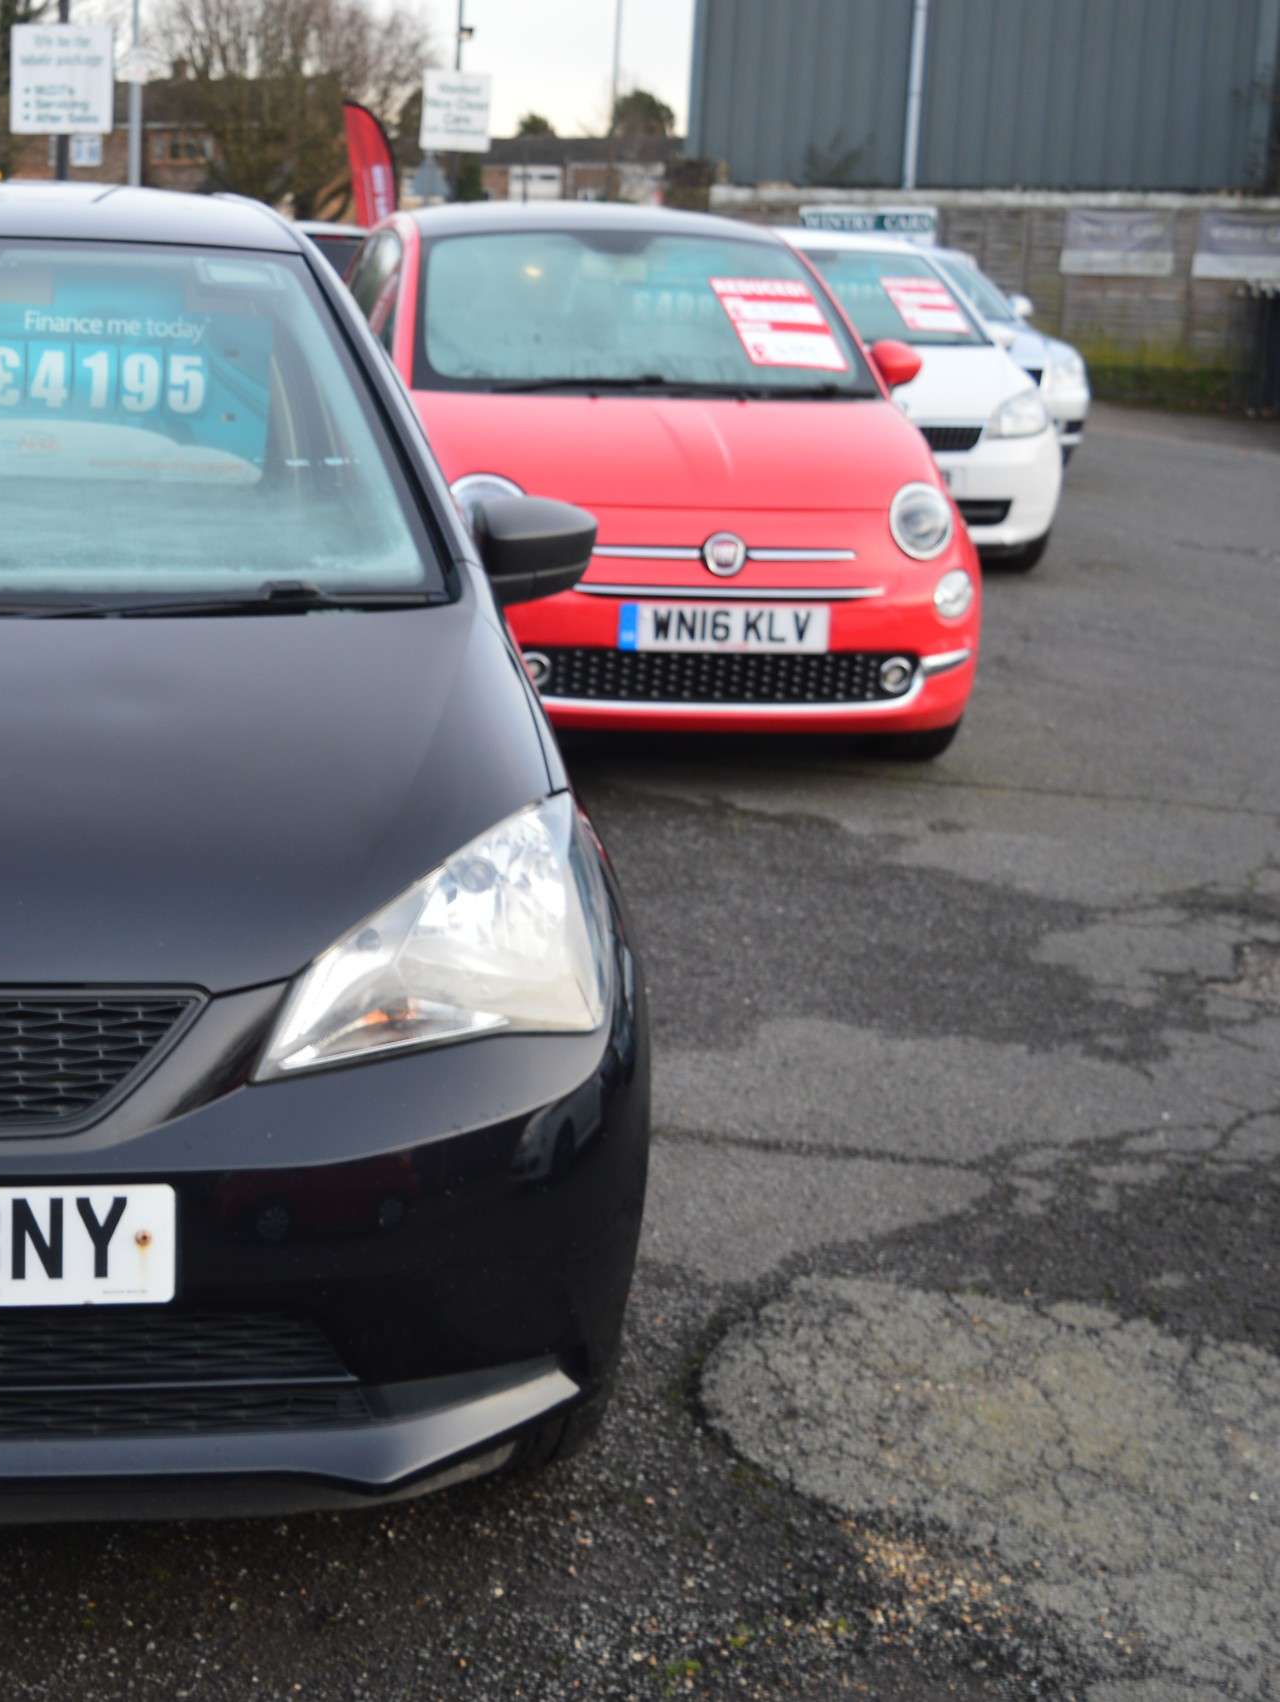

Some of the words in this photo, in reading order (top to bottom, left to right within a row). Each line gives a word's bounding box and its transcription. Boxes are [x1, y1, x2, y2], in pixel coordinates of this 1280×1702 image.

[24, 310, 103, 336] Finance
[107, 318, 142, 337] me
[652, 609, 731, 642] WN16
[743, 610, 811, 642] KLV
